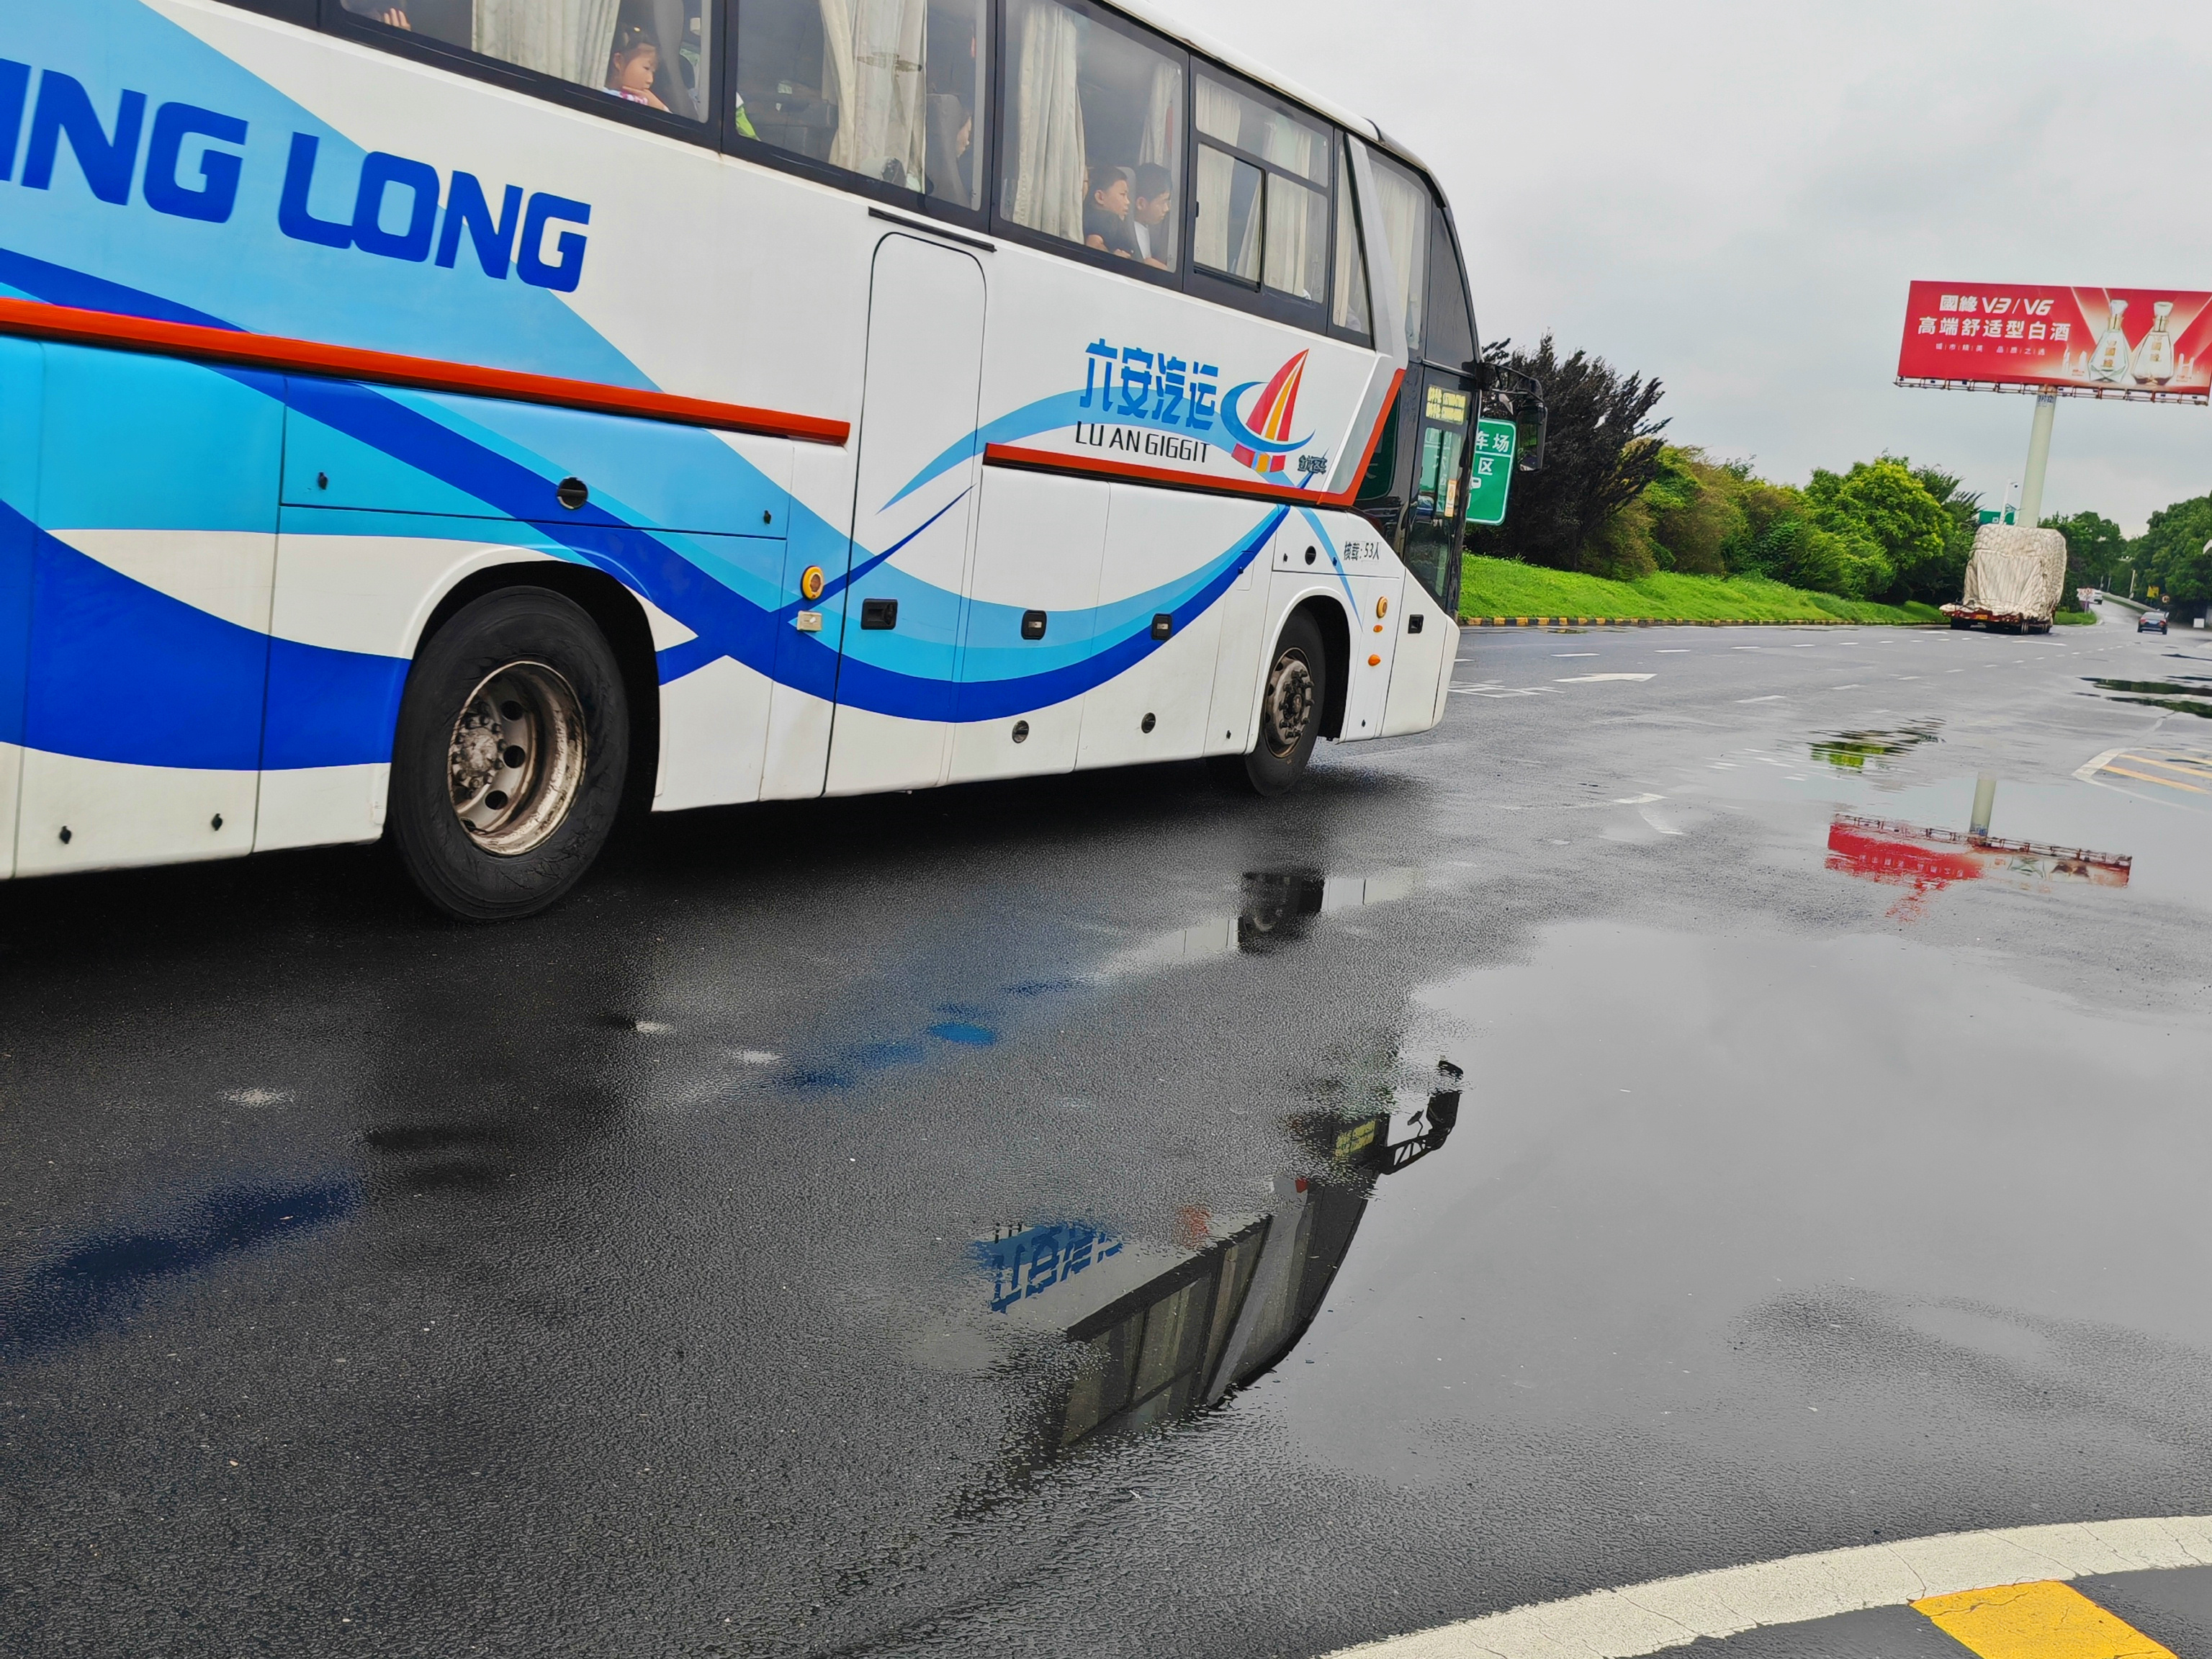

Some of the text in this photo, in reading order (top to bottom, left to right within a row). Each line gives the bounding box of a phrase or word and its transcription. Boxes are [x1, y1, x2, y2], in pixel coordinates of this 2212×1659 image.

[278, 131, 592, 293] LONG
[1939, 295, 1978, 313] 國緣
[1917, 316, 2071, 342] 高端舒适型白酒
[1079, 338, 1218, 431] 六安汽运
[1075, 421, 1210, 463] LU AN GIGGIT
